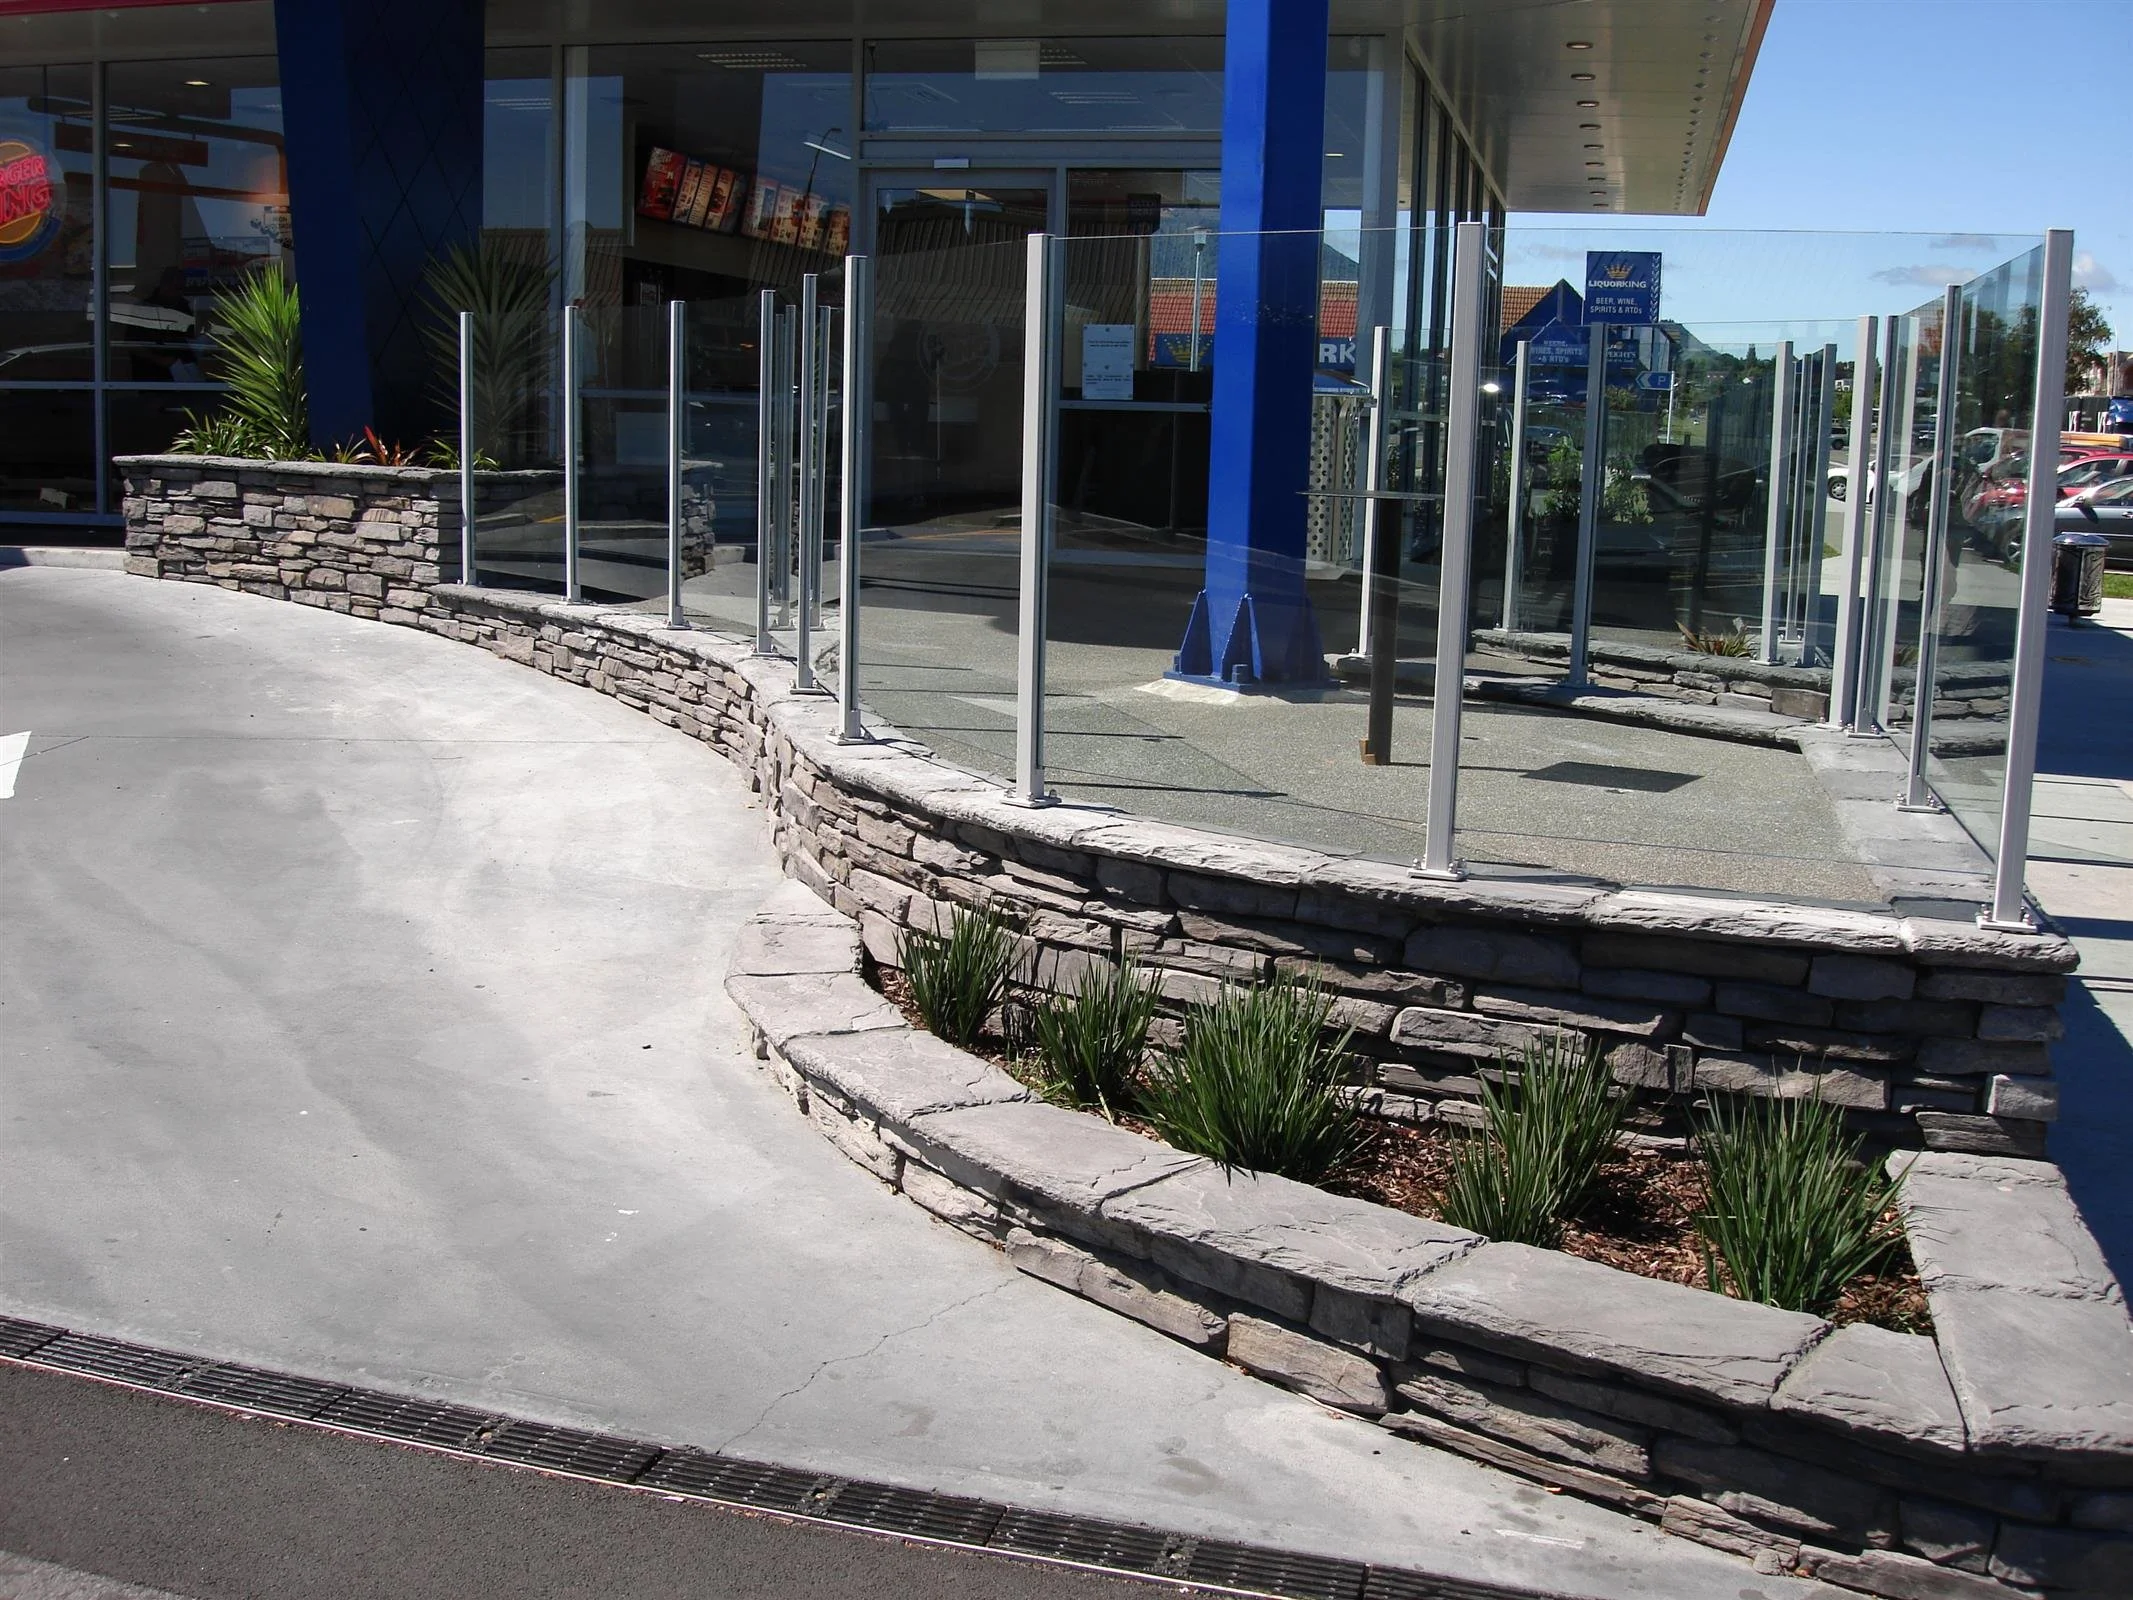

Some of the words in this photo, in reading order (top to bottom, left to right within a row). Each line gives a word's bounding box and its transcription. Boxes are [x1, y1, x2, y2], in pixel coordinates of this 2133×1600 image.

[1588, 280, 1647, 289] LIQUORKING
[1590, 306, 1617, 314] SPIRITS
[1657, 375, 1666, 386] P
